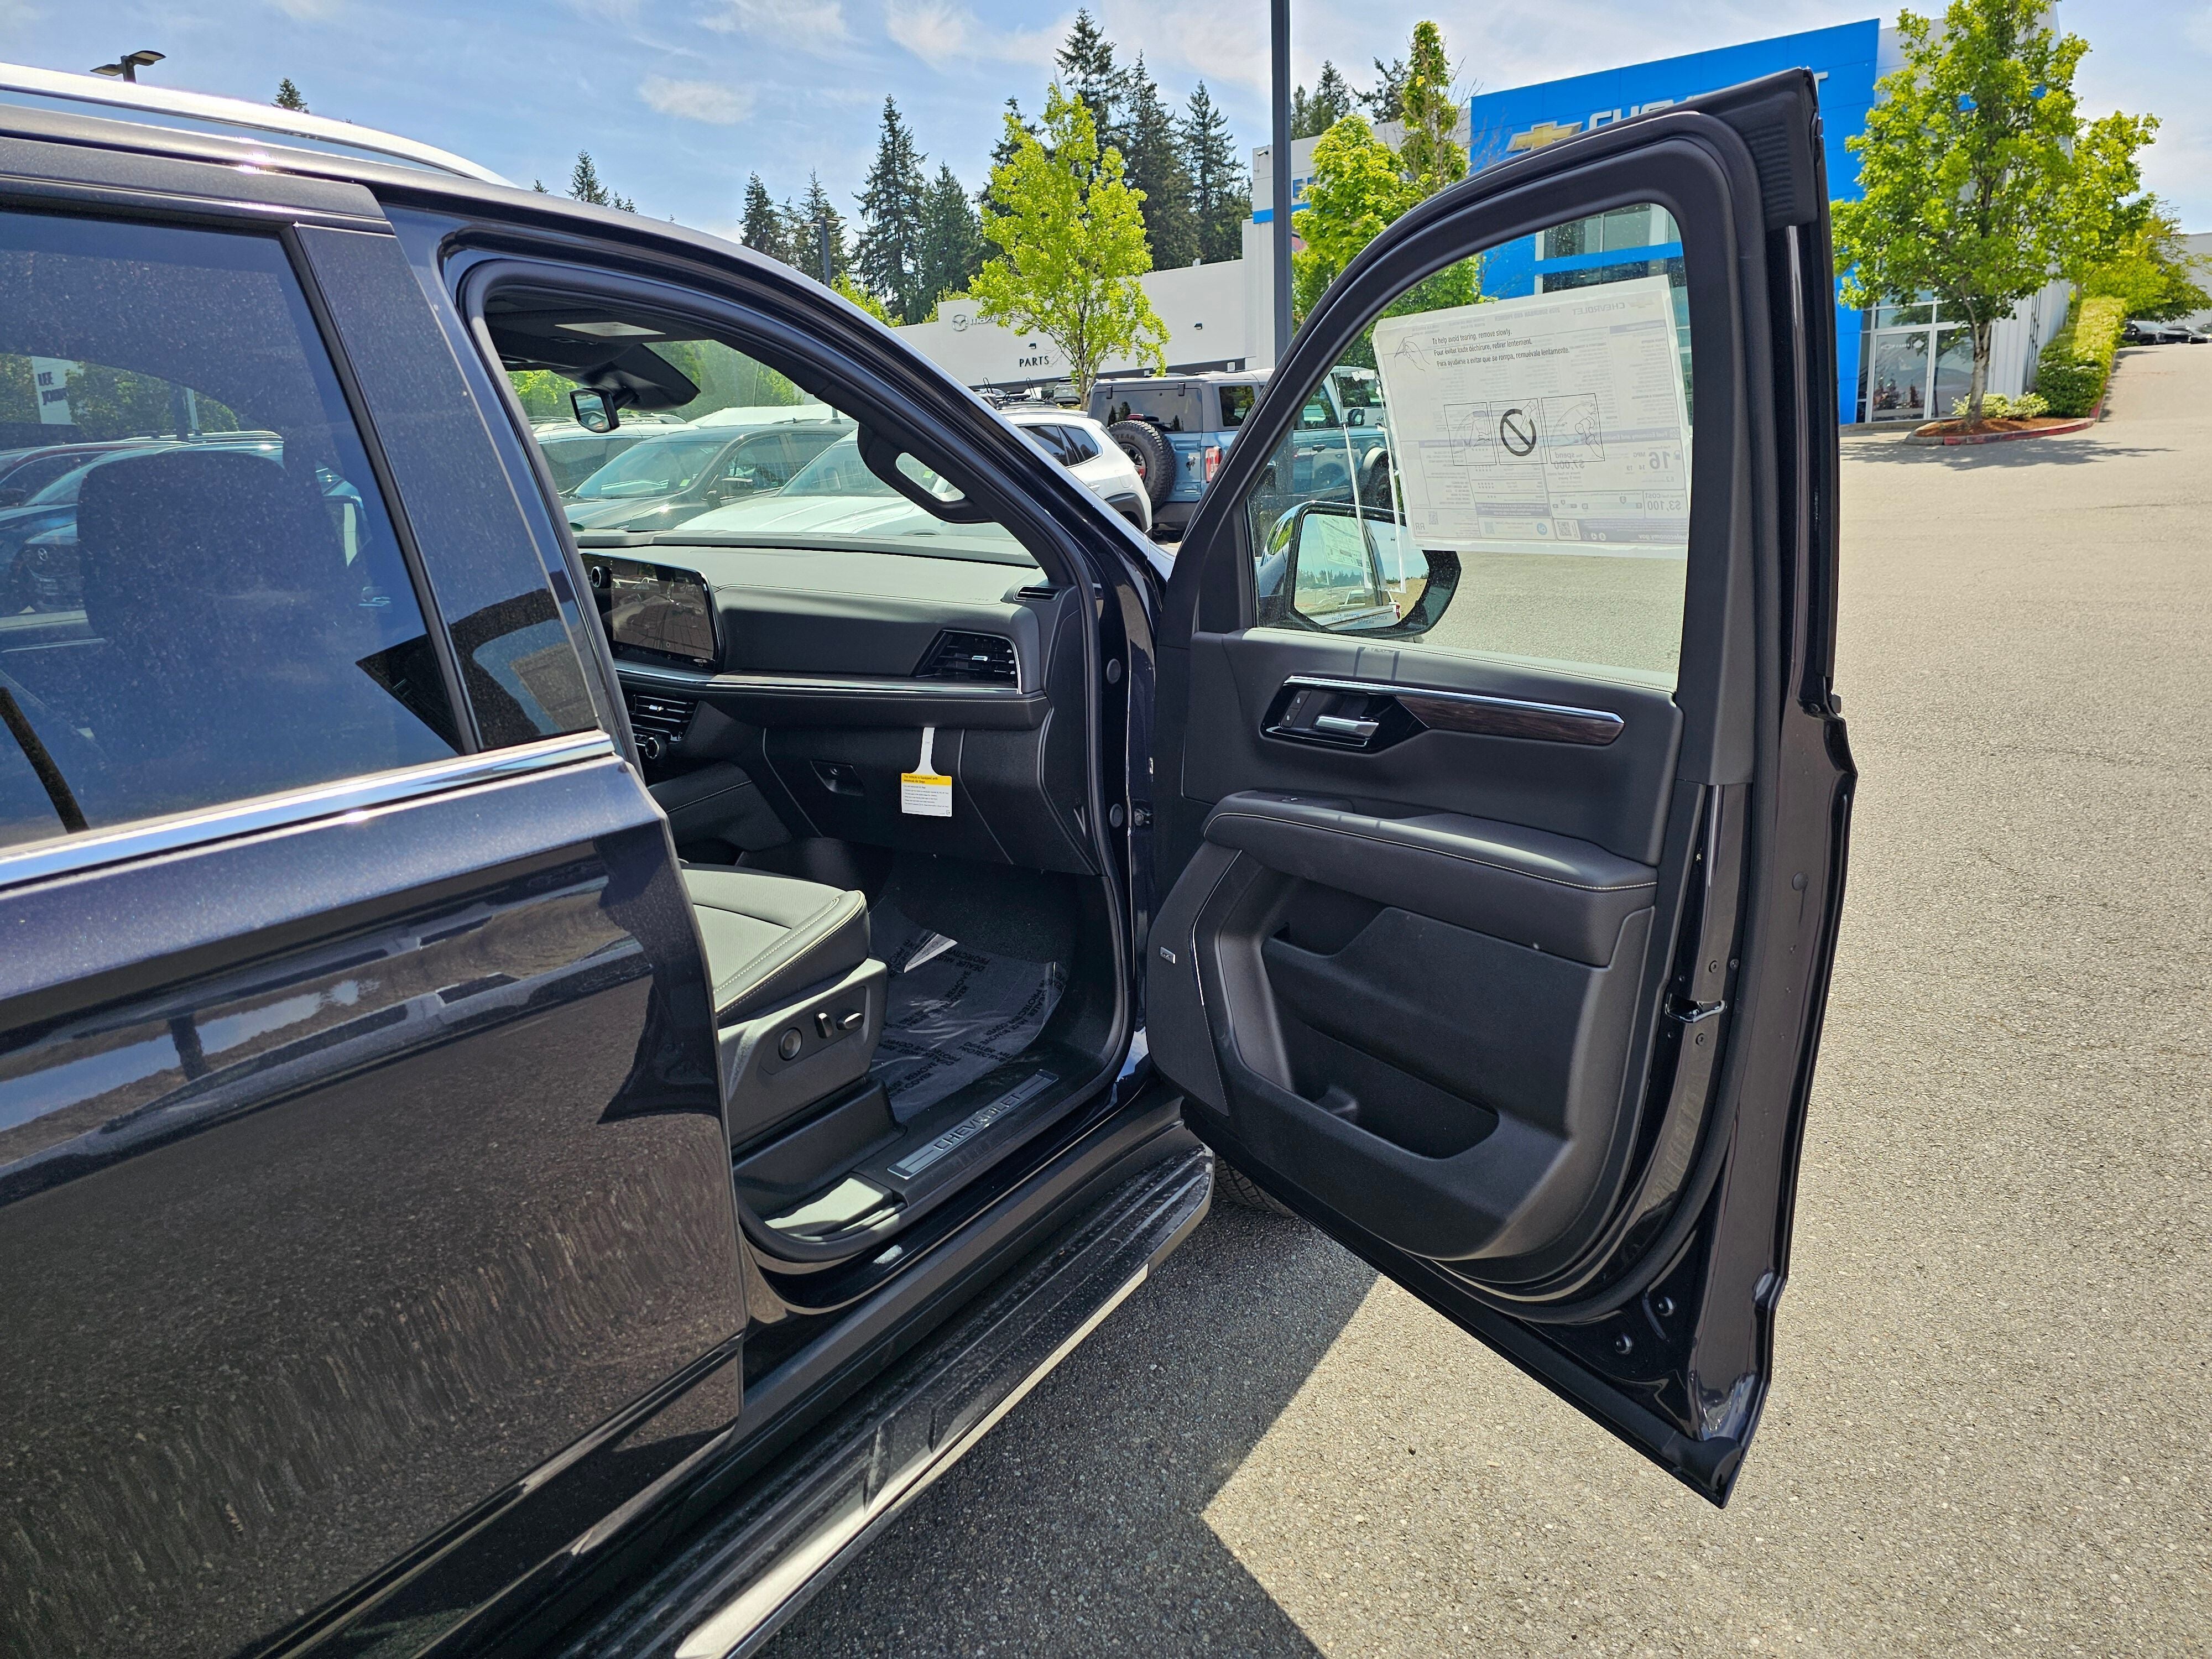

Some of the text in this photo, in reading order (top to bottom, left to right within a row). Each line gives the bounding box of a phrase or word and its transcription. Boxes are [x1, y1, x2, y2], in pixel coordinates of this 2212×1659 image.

[1496, 328, 1512, 336] slowly.
[1019, 356, 1050, 368] PARTS
[1448, 358, 1466, 367] ayudarse
[1541, 347, 1570, 356] lentamente.
[945, 948, 990, 965] PROTECTIVE
[956, 960, 985, 972] DEALER
[933, 1092, 1020, 1151] CHEVROLET
